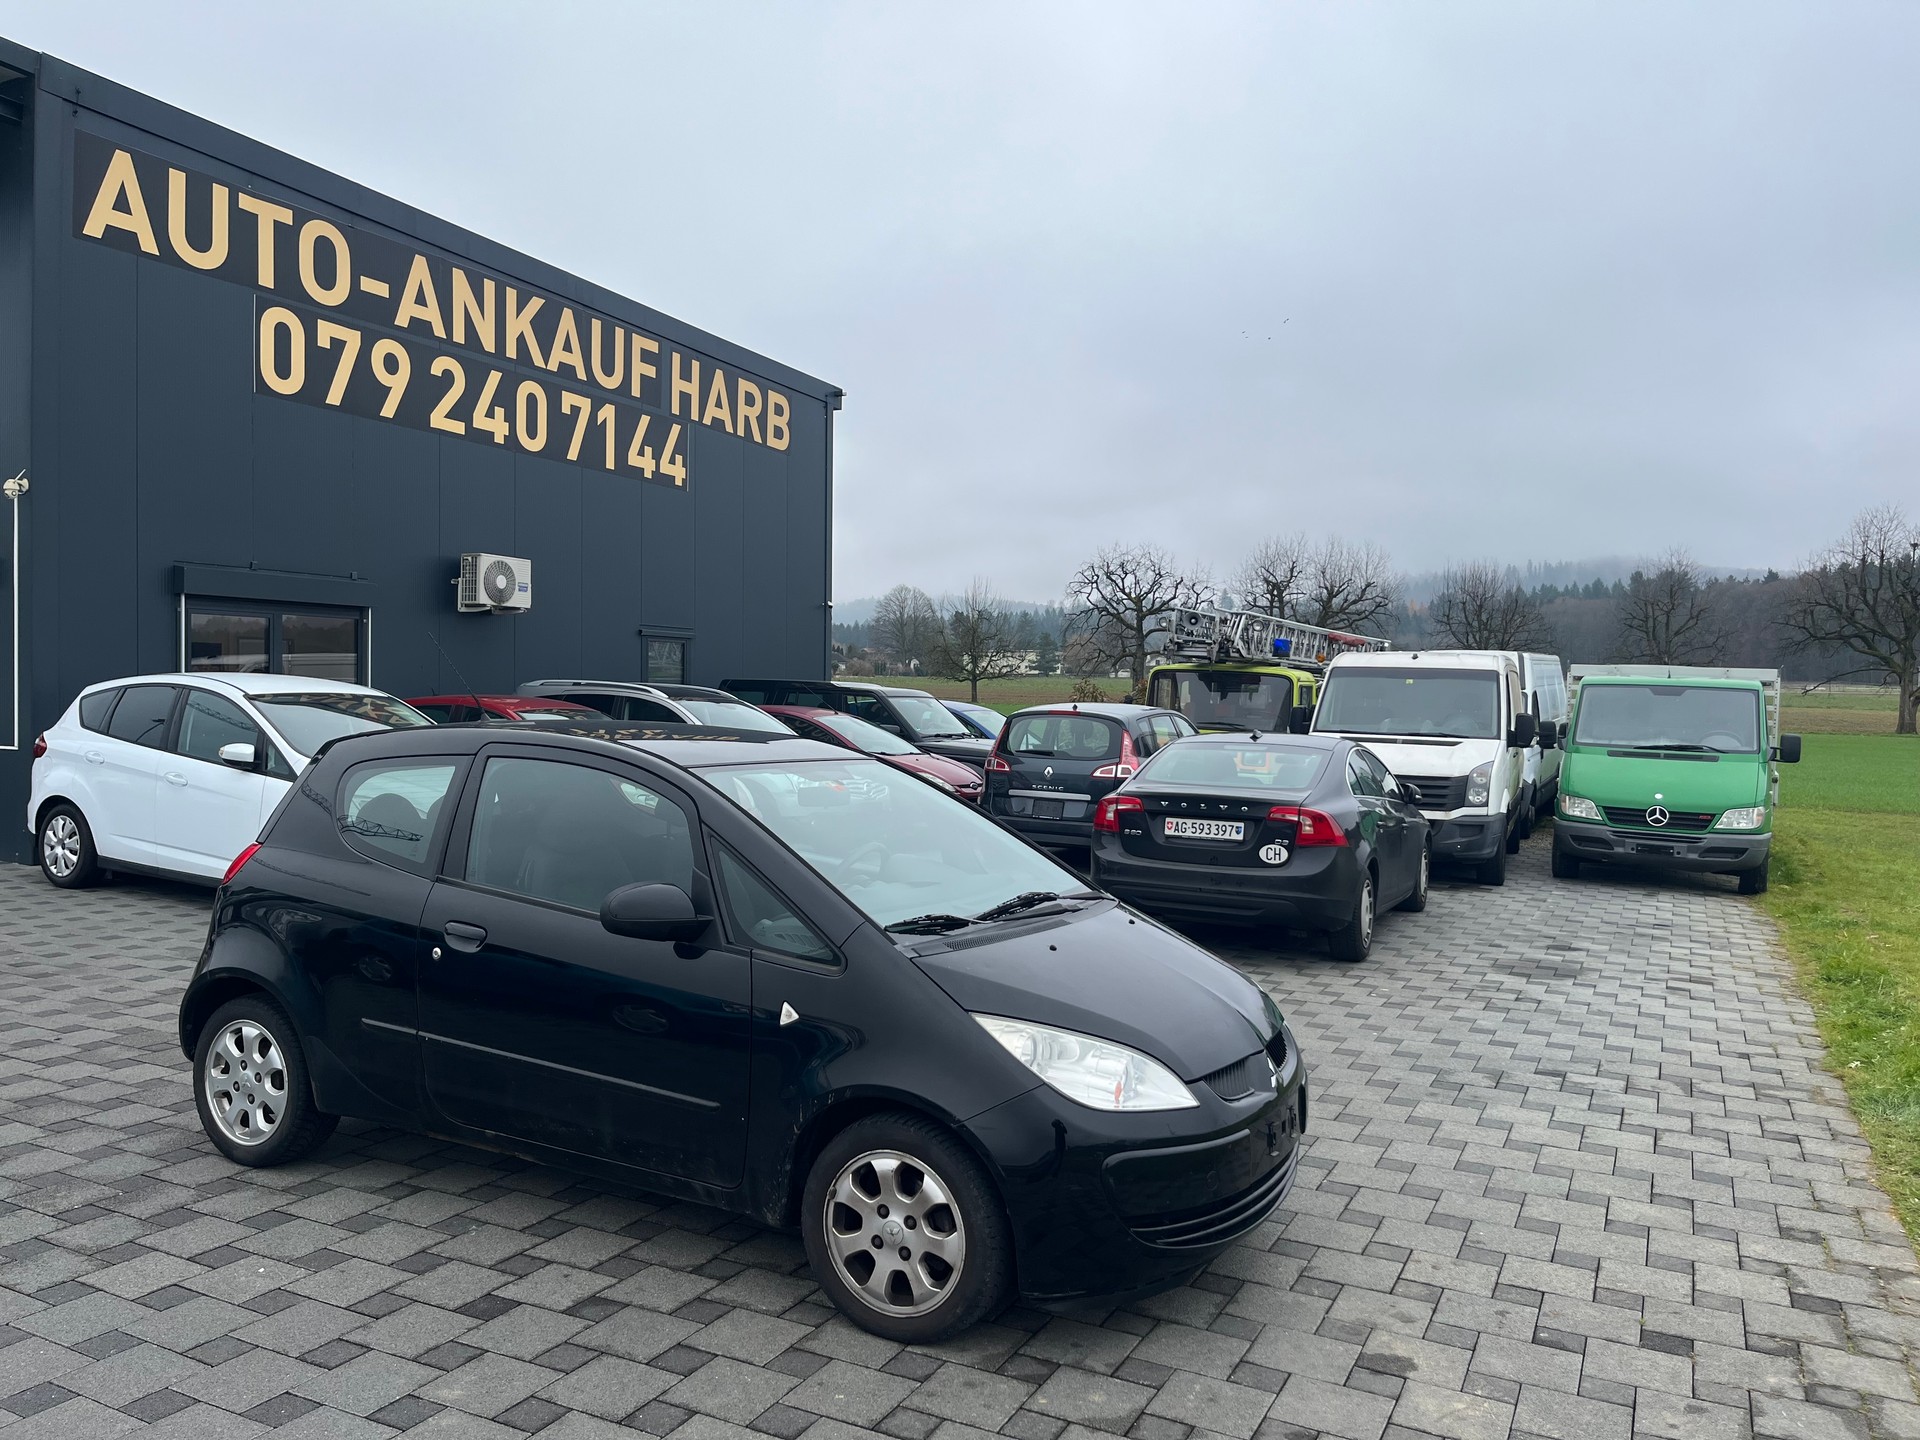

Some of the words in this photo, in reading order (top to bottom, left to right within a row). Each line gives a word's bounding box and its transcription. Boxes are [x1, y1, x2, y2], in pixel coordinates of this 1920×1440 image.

[83, 149, 660, 397] AUTO-ANKAUF
[671, 352, 791, 451] HARB
[260, 306, 411, 418] 079
[430, 355, 548, 452] 240
[561, 391, 616, 470] 71
[627, 415, 687, 486] 44
[1160, 801, 1248, 812] VOLVO
[1265, 846, 1281, 861] CH
